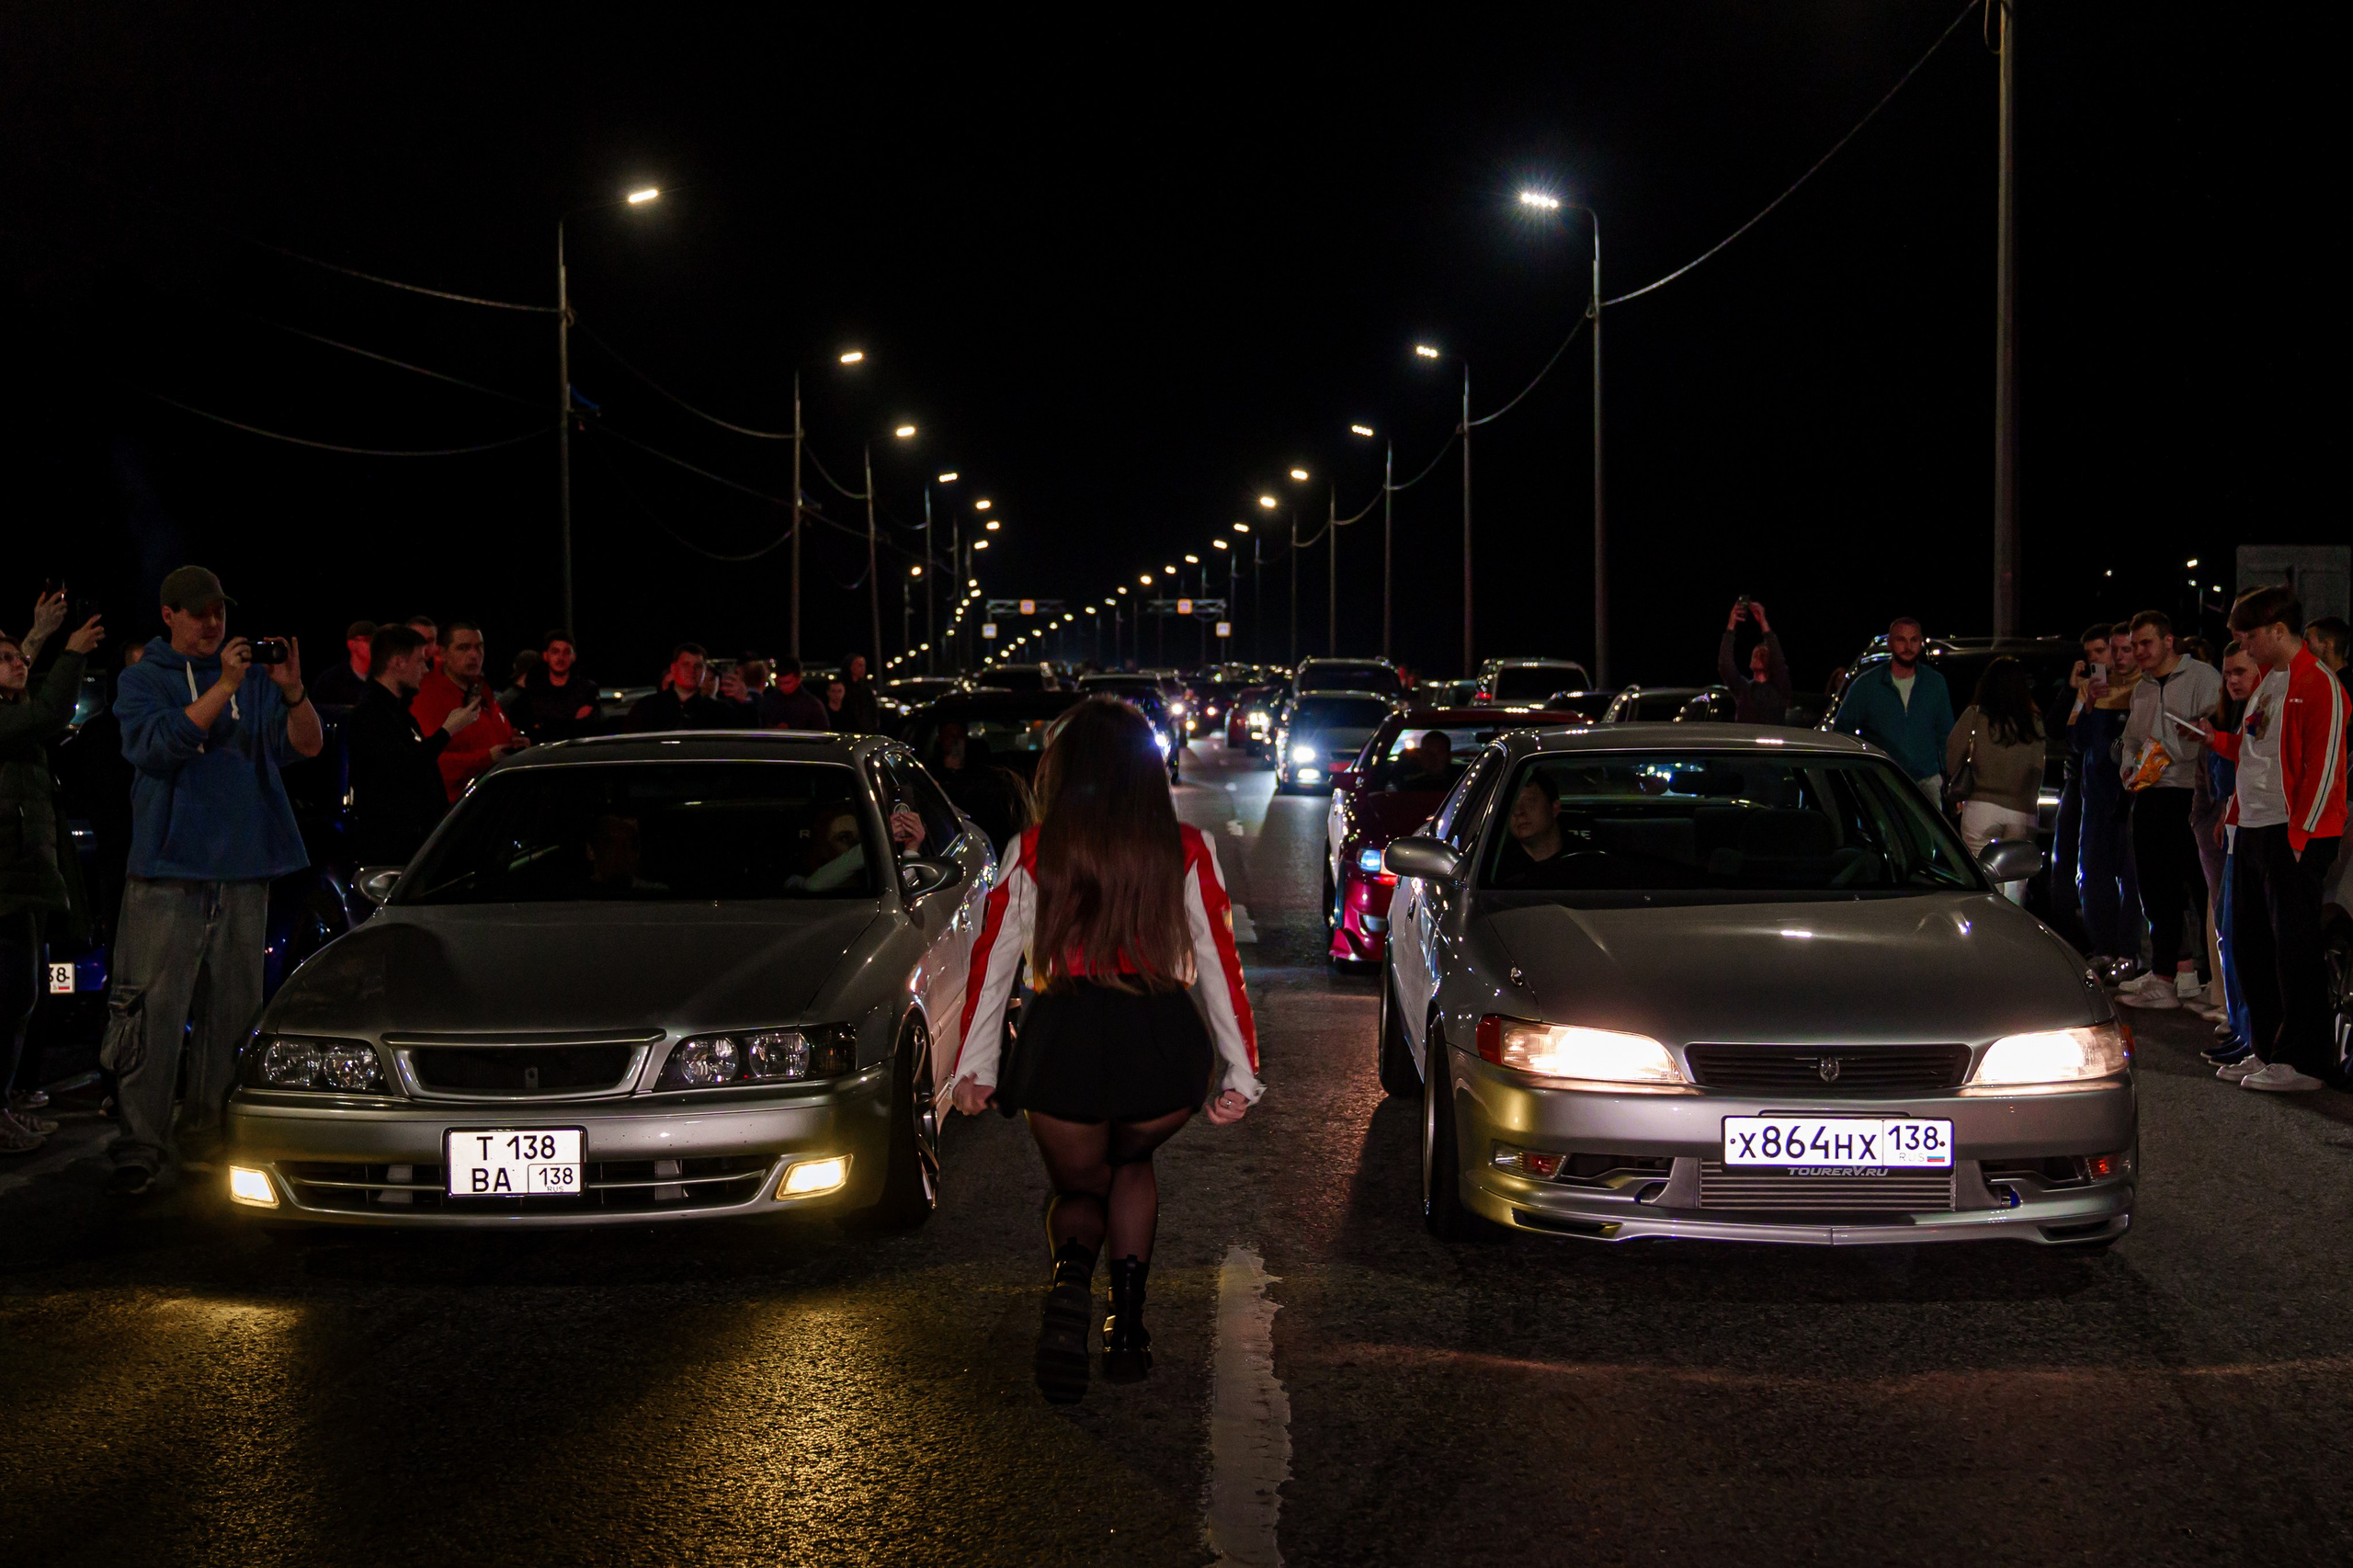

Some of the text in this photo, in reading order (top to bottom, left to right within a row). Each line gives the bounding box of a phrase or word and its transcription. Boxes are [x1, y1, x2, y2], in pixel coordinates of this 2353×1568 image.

[476, 1134, 556, 1161] Т 138
[1738, 1125, 1939, 1161] Х864НХ 138
[1786, 1165, 1890, 1176] TOURERV.RU
[1898, 1152, 1926, 1163] RUS
[472, 1167, 574, 1193] ВА 138
